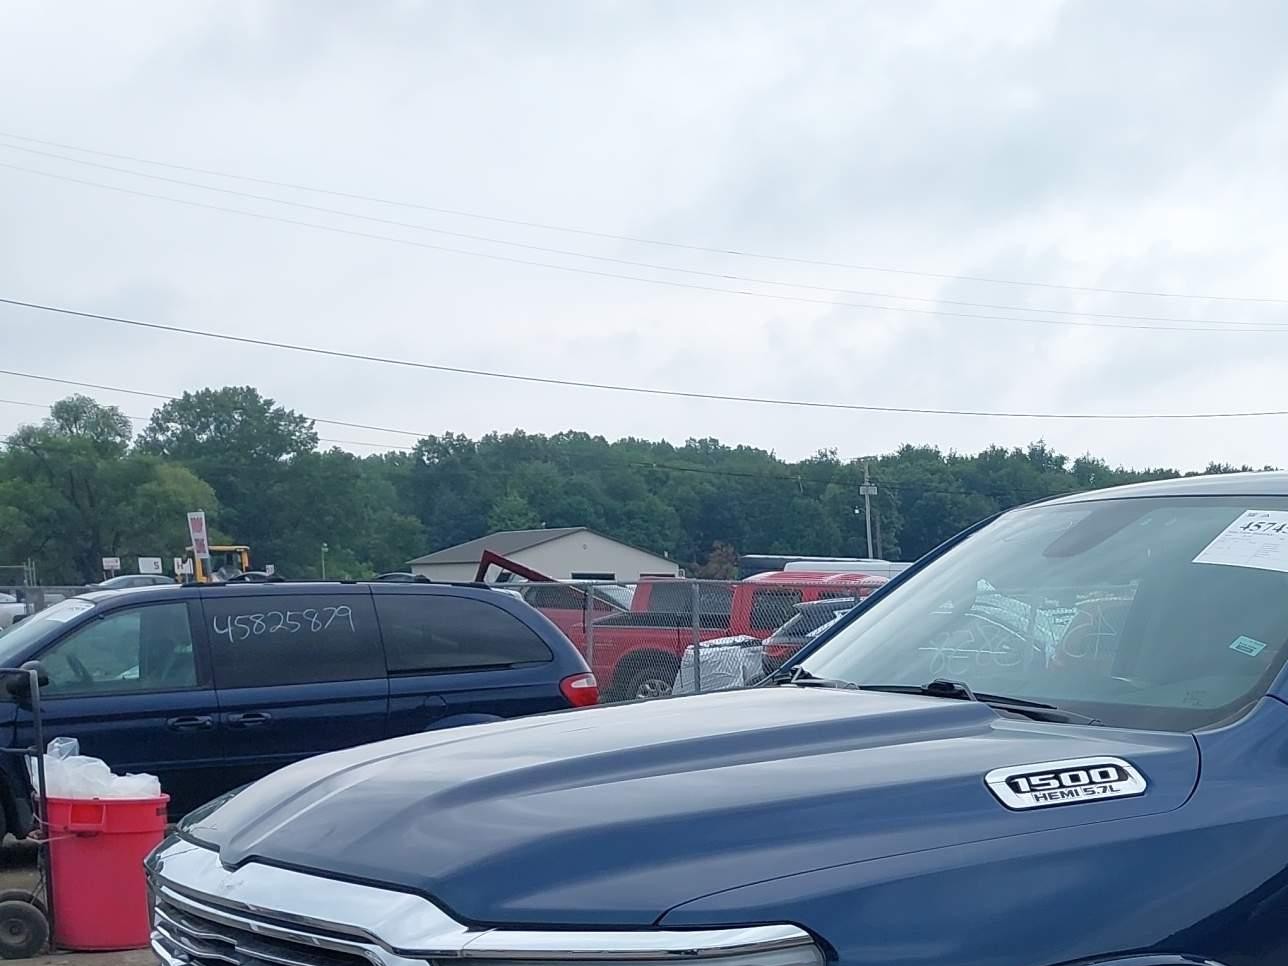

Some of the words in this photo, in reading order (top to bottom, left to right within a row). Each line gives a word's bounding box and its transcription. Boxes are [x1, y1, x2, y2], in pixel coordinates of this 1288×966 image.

[213, 605, 356, 643] 45825879
[1010, 766, 1119, 792] 1500
[1033, 789, 1080, 802] HEMI
[1083, 784, 1121, 796] 5.7L
